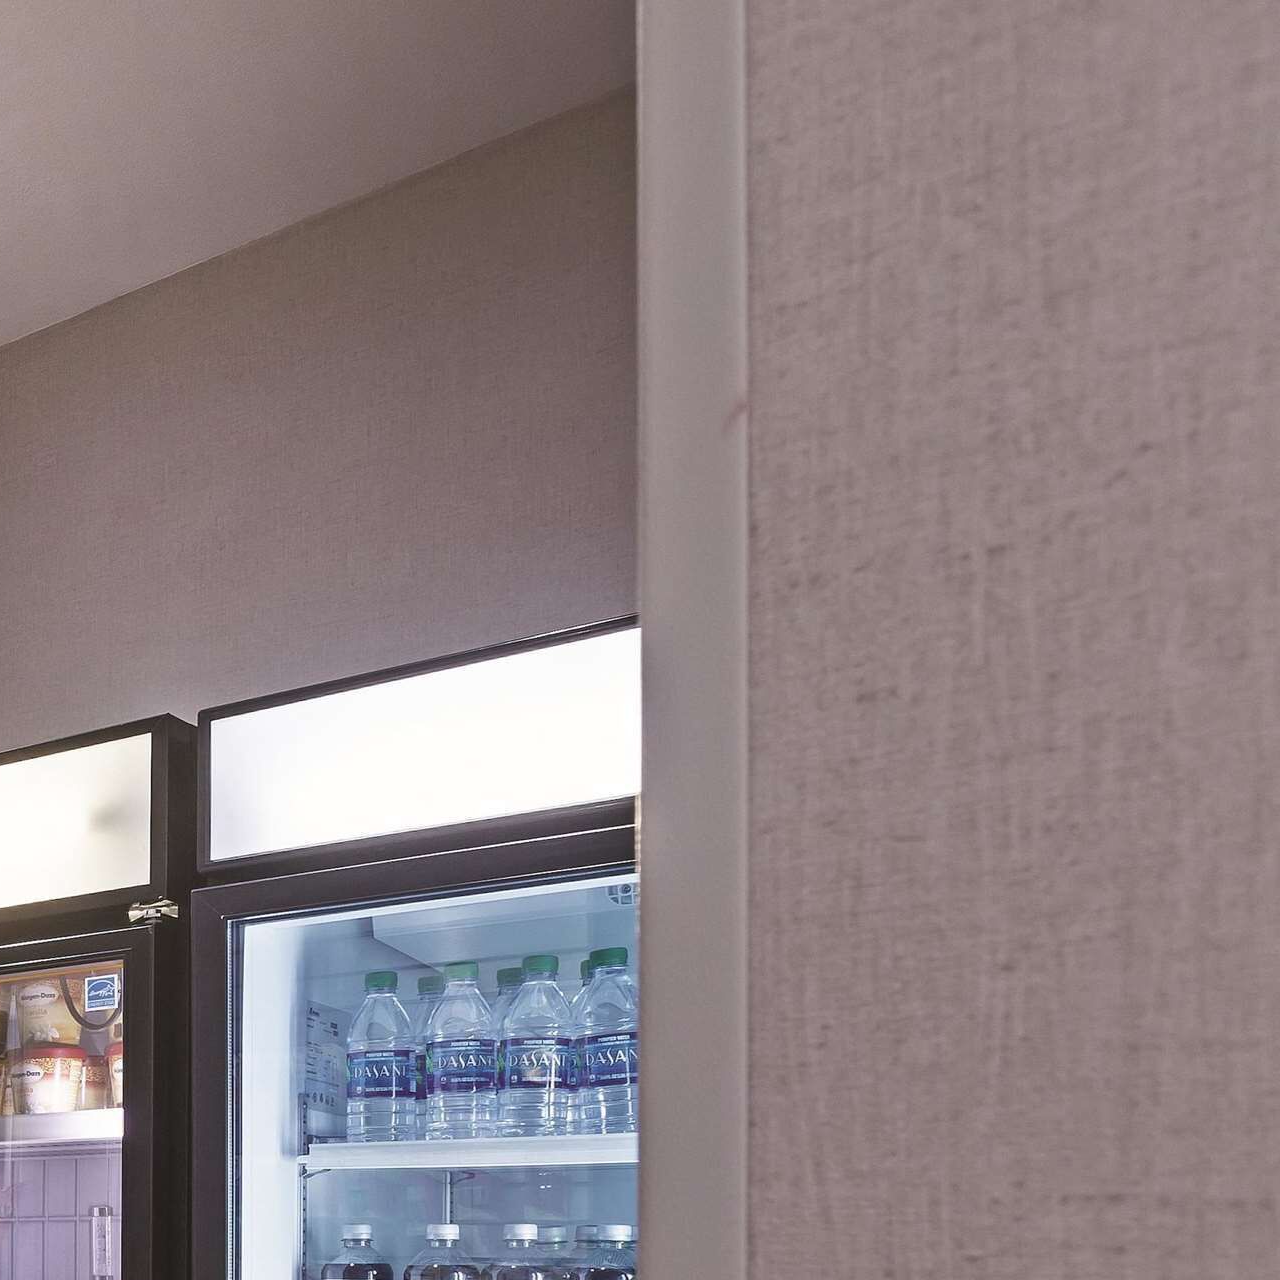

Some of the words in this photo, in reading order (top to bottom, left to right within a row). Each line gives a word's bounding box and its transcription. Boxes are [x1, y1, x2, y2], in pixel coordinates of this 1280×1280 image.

[437, 1052, 493, 1069] DASANI
[508, 1050, 567, 1068] DASANI
[353, 1064, 407, 1079] DASANI
